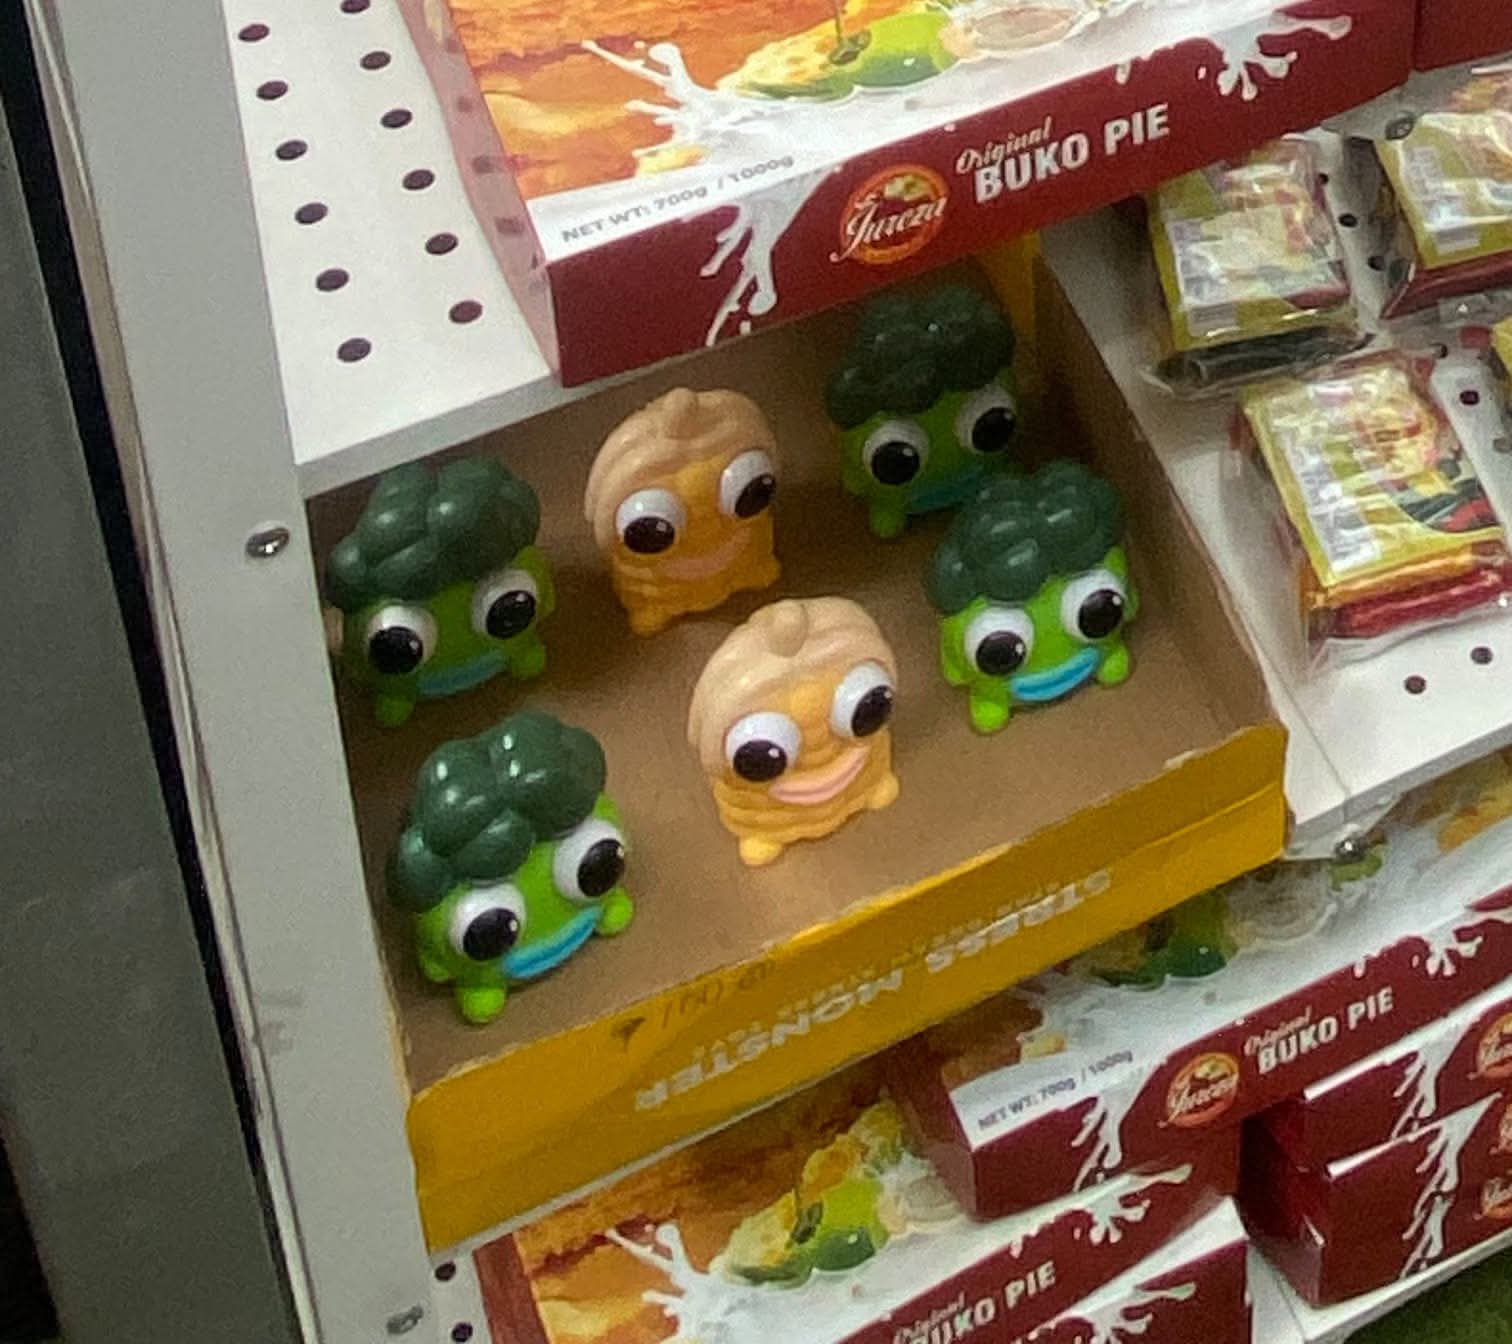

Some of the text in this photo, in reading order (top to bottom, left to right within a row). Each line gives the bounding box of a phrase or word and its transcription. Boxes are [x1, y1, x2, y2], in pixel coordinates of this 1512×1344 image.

[955, 116, 1053, 175] Original
[974, 103, 1171, 204] BUKO PIE
[561, 219, 607, 244] NET
[653, 184, 709, 214] 700g
[726, 154, 795, 184] 1000g
[829, 200, 947, 263] Jureza
[924, 868, 1112, 974] STRESS
[633, 966, 906, 1111] MONSTER
[1257, 986, 1394, 1075] BUKO PIE
[1004, 1259, 1058, 1311] PIE
